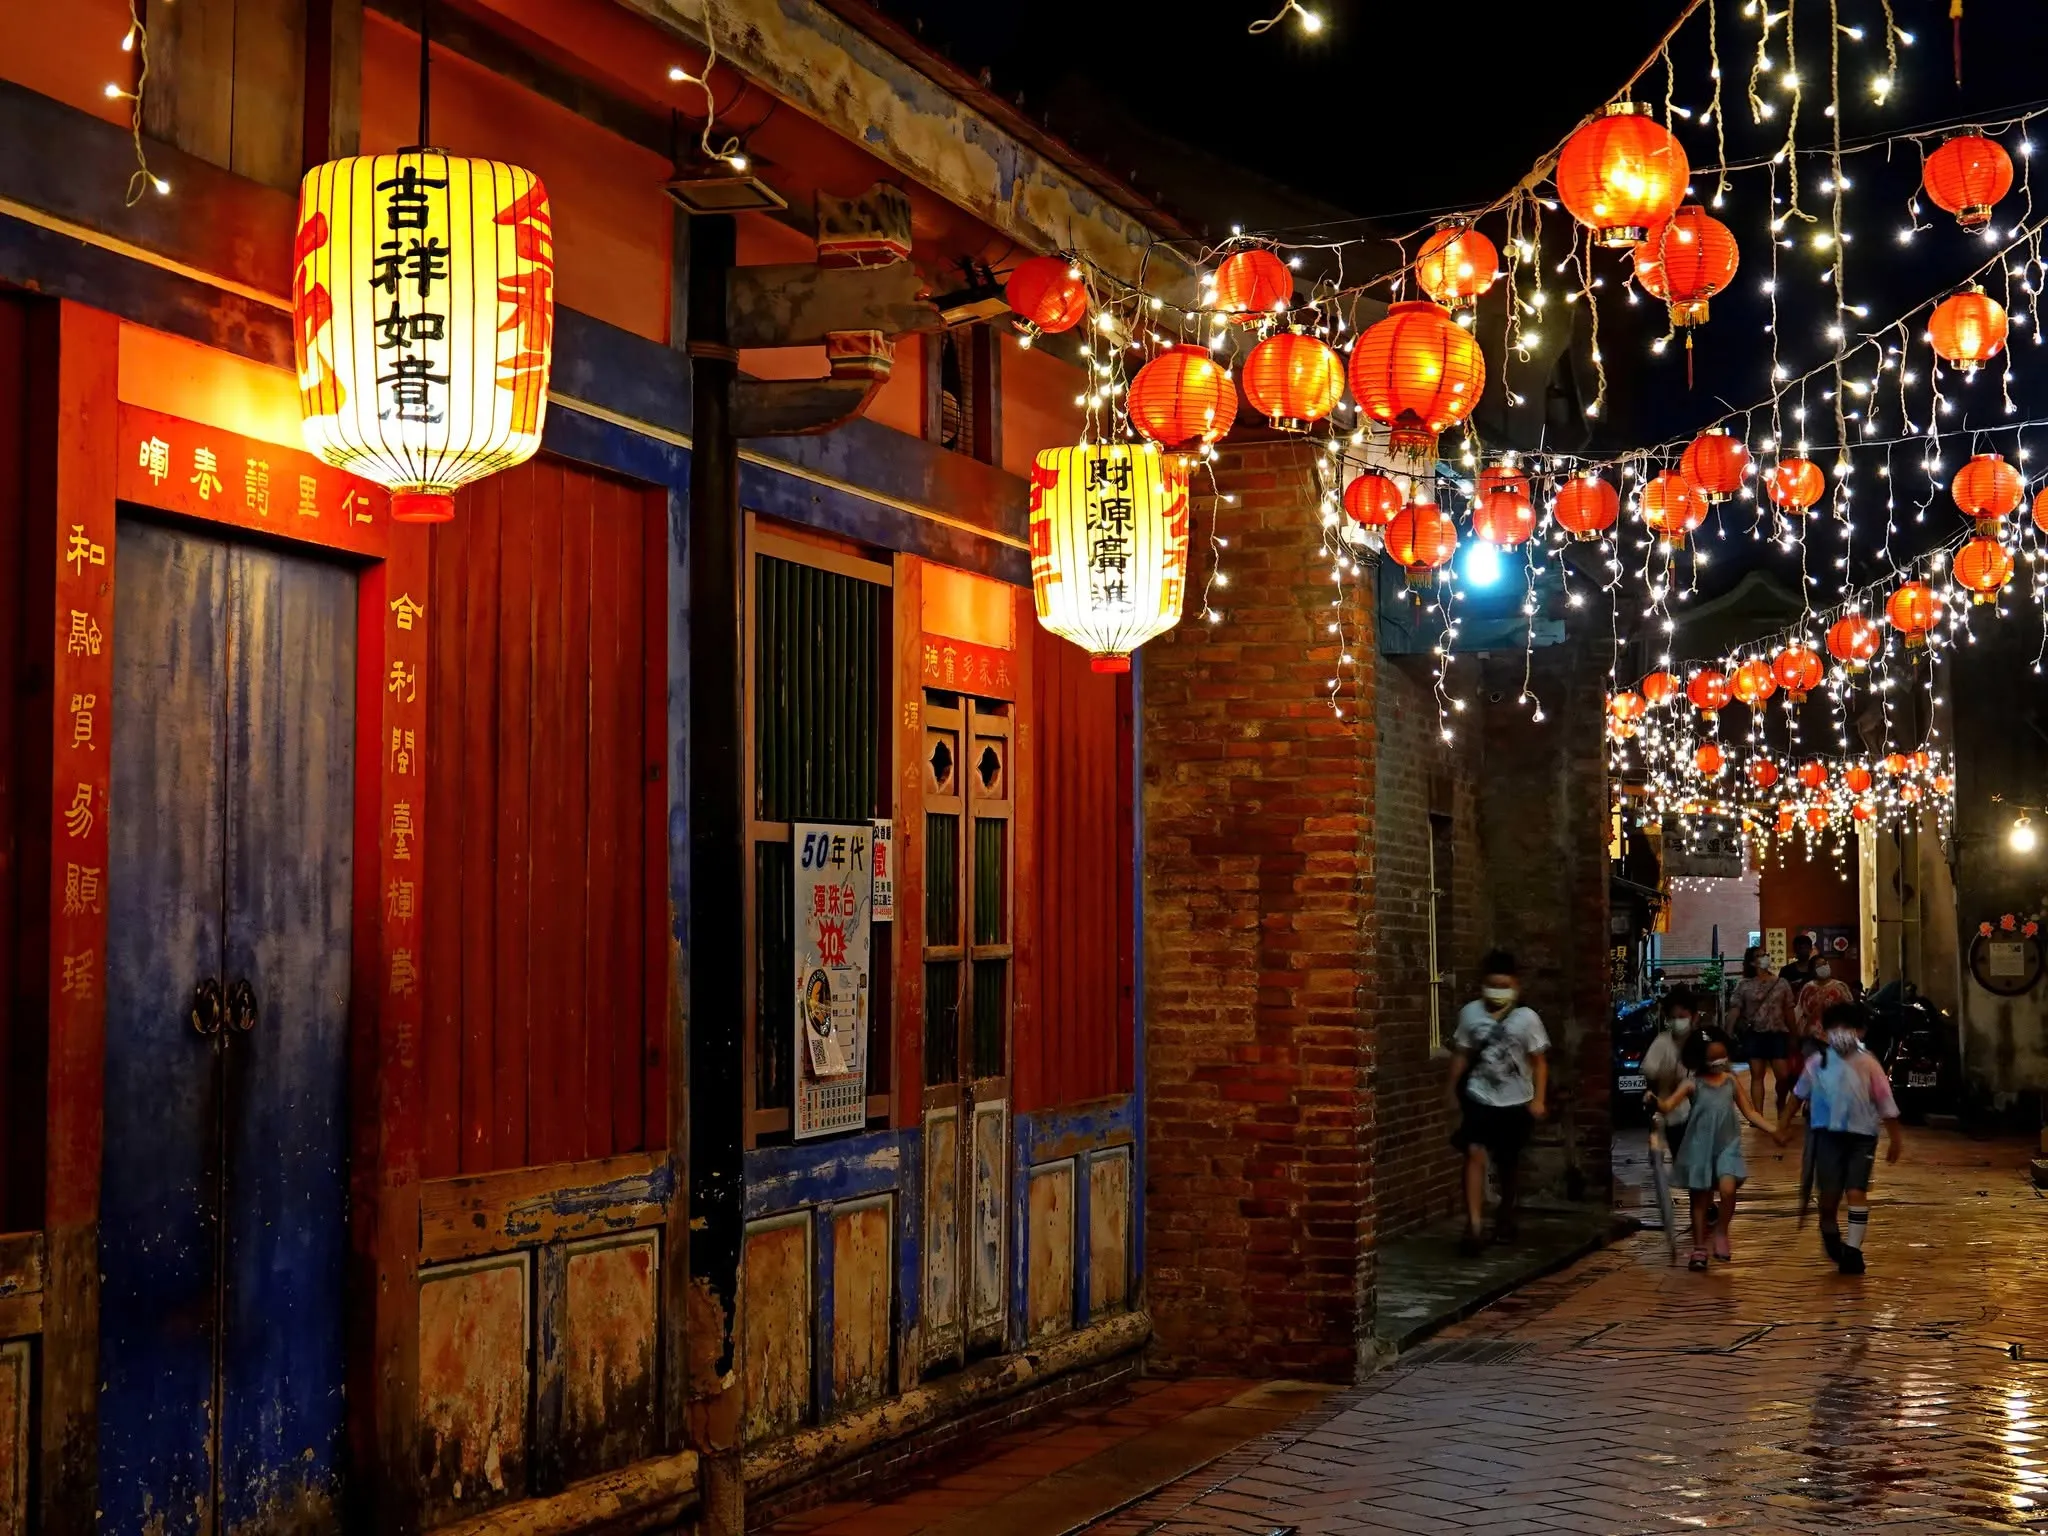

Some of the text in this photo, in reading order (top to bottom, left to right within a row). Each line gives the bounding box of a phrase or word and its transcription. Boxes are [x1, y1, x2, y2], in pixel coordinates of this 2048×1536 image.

[368, 166, 450, 424] 吉祥如意
[1086, 456, 1135, 613] 財源廣進
[801, 834, 865, 871] 50年代
[813, 884, 855, 917] 彈珠台
